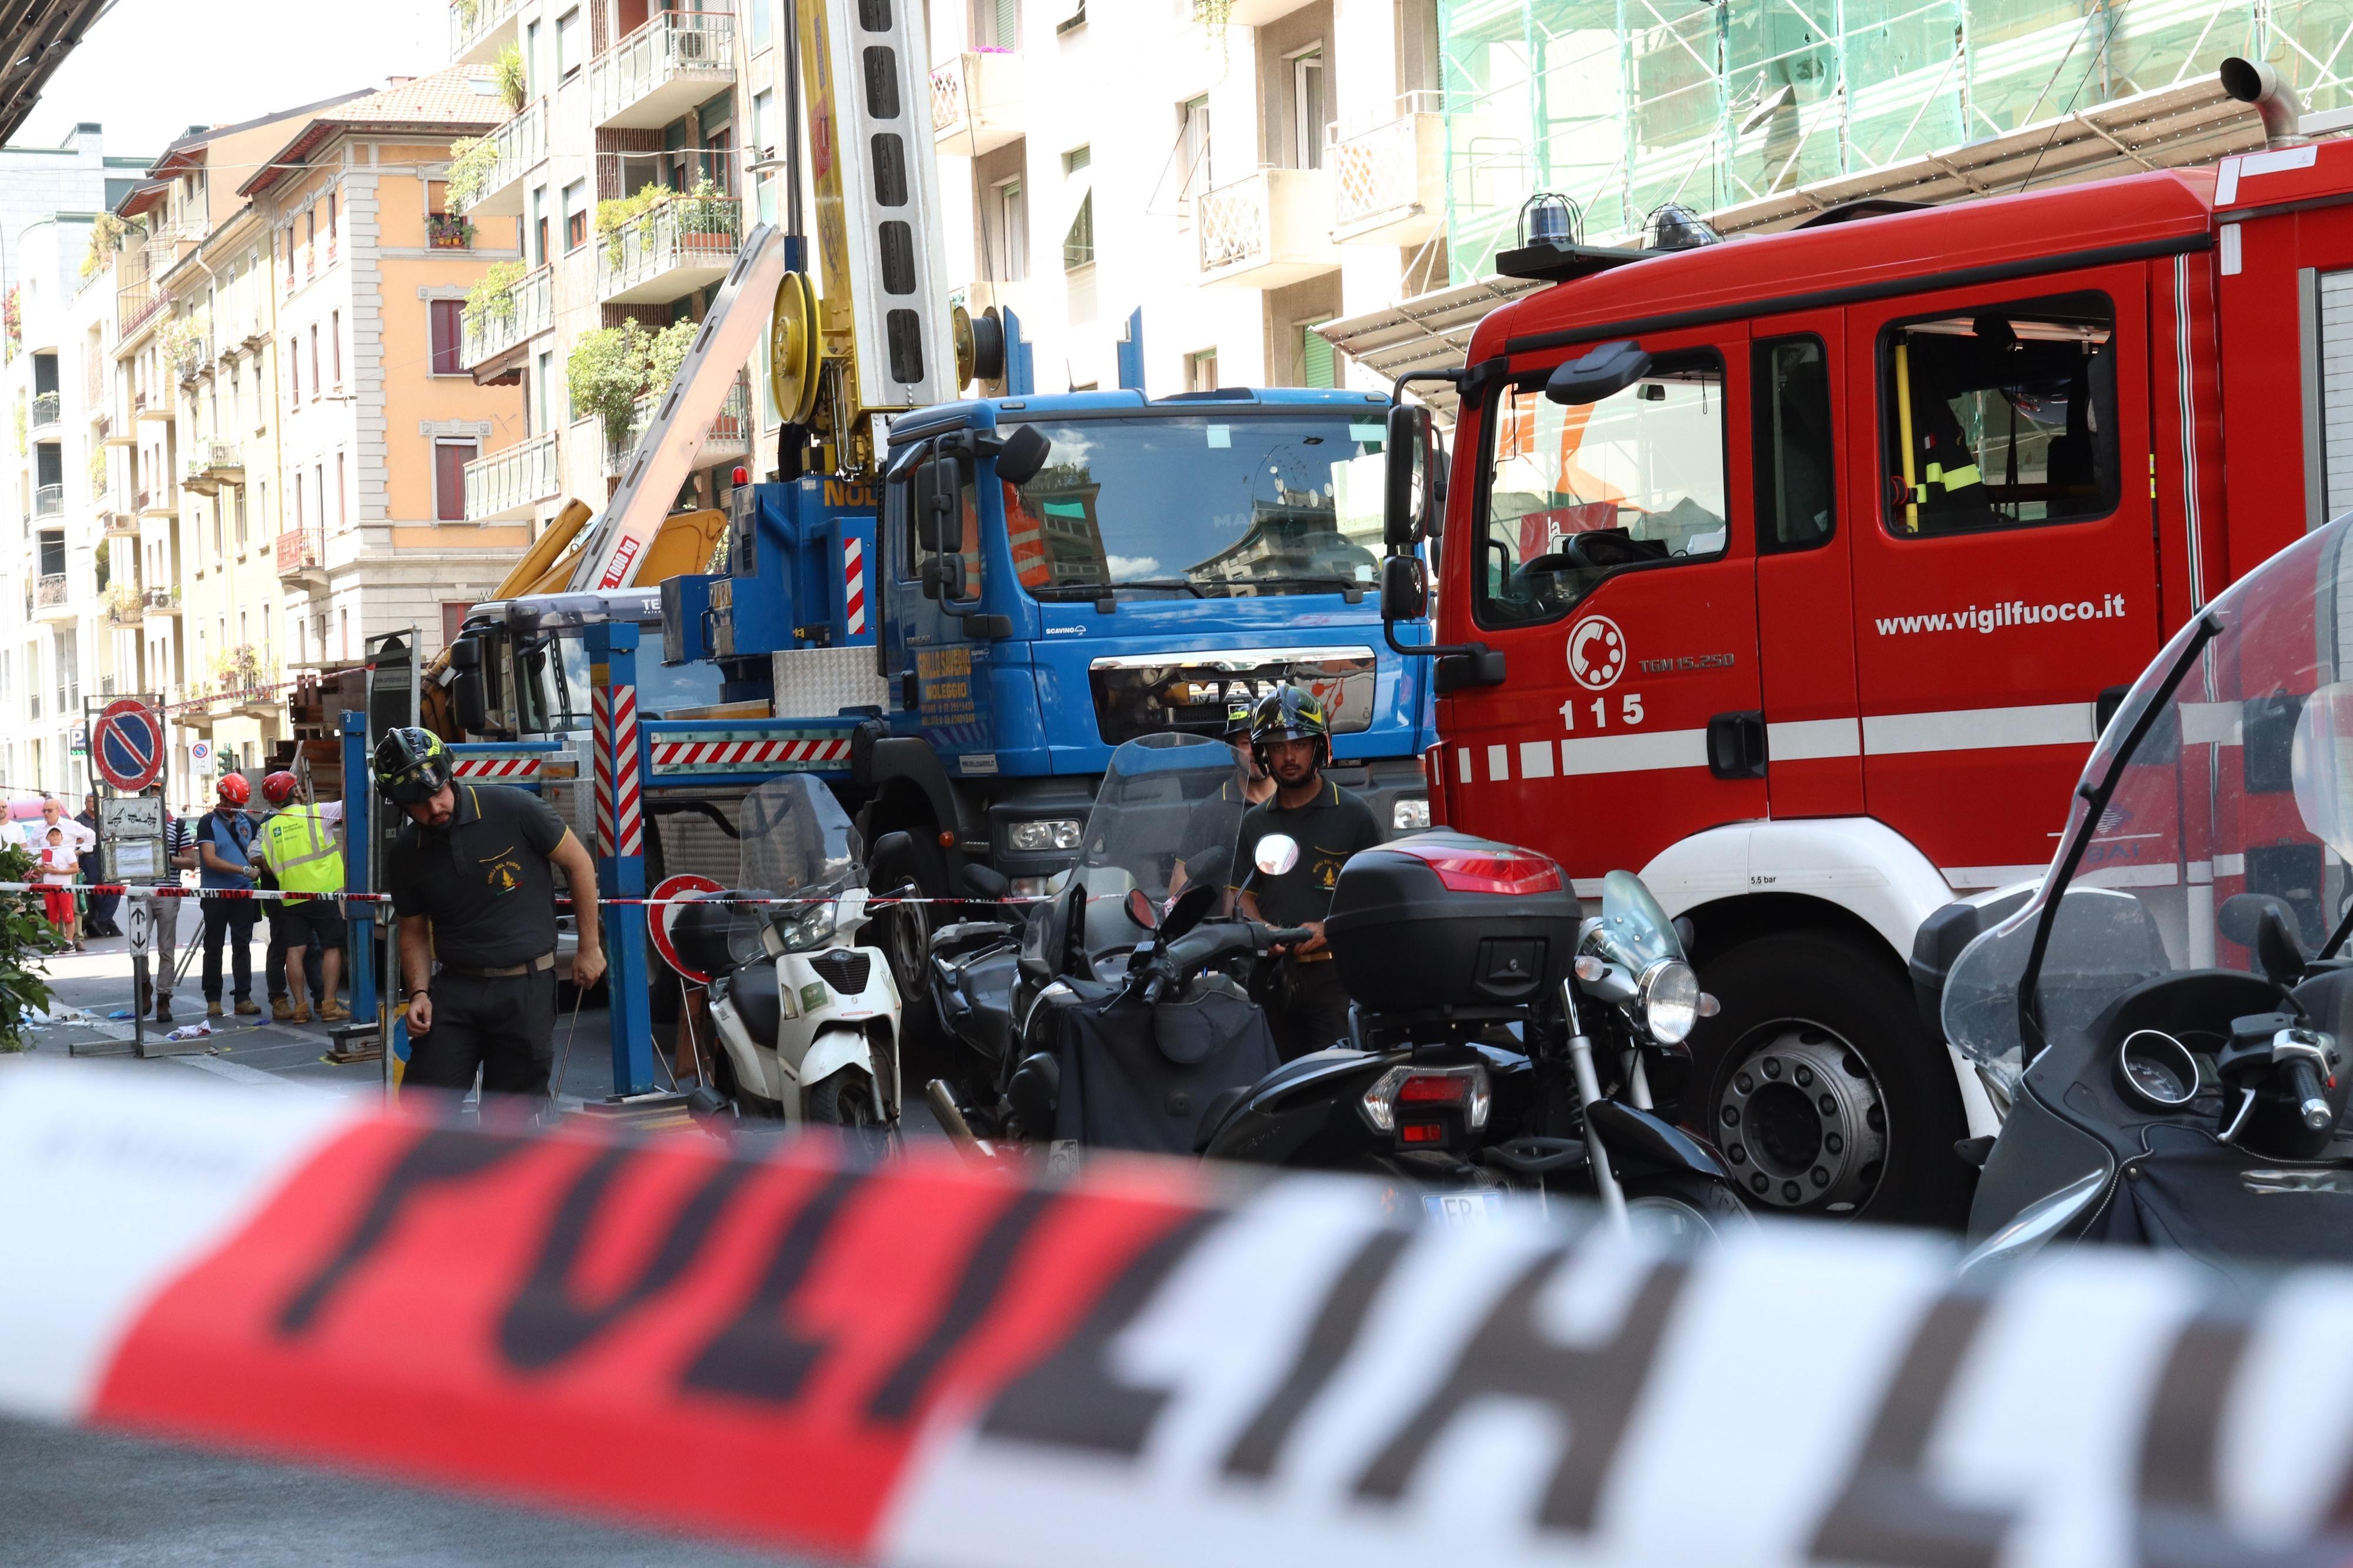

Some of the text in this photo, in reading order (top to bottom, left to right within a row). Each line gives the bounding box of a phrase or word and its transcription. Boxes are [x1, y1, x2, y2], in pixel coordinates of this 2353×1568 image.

[606, 552, 629, 582] 1000
[619, 539, 638, 556] kg
[641, 599, 662, 610] TE
[1875, 593, 2126, 635] www.vigilfuoco.it
[918, 651, 941, 680] GRILLO
[1639, 653, 1735, 673] TGM 15.250
[926, 682, 967, 700] NOLEGGIO
[346, 713, 351, 723] 3
[71, 729, 84, 747] P
[495, 862, 505, 870] DEL
[506, 861, 521, 870] FUOCO
[1751, 875, 1777, 885] 5.5 bar
